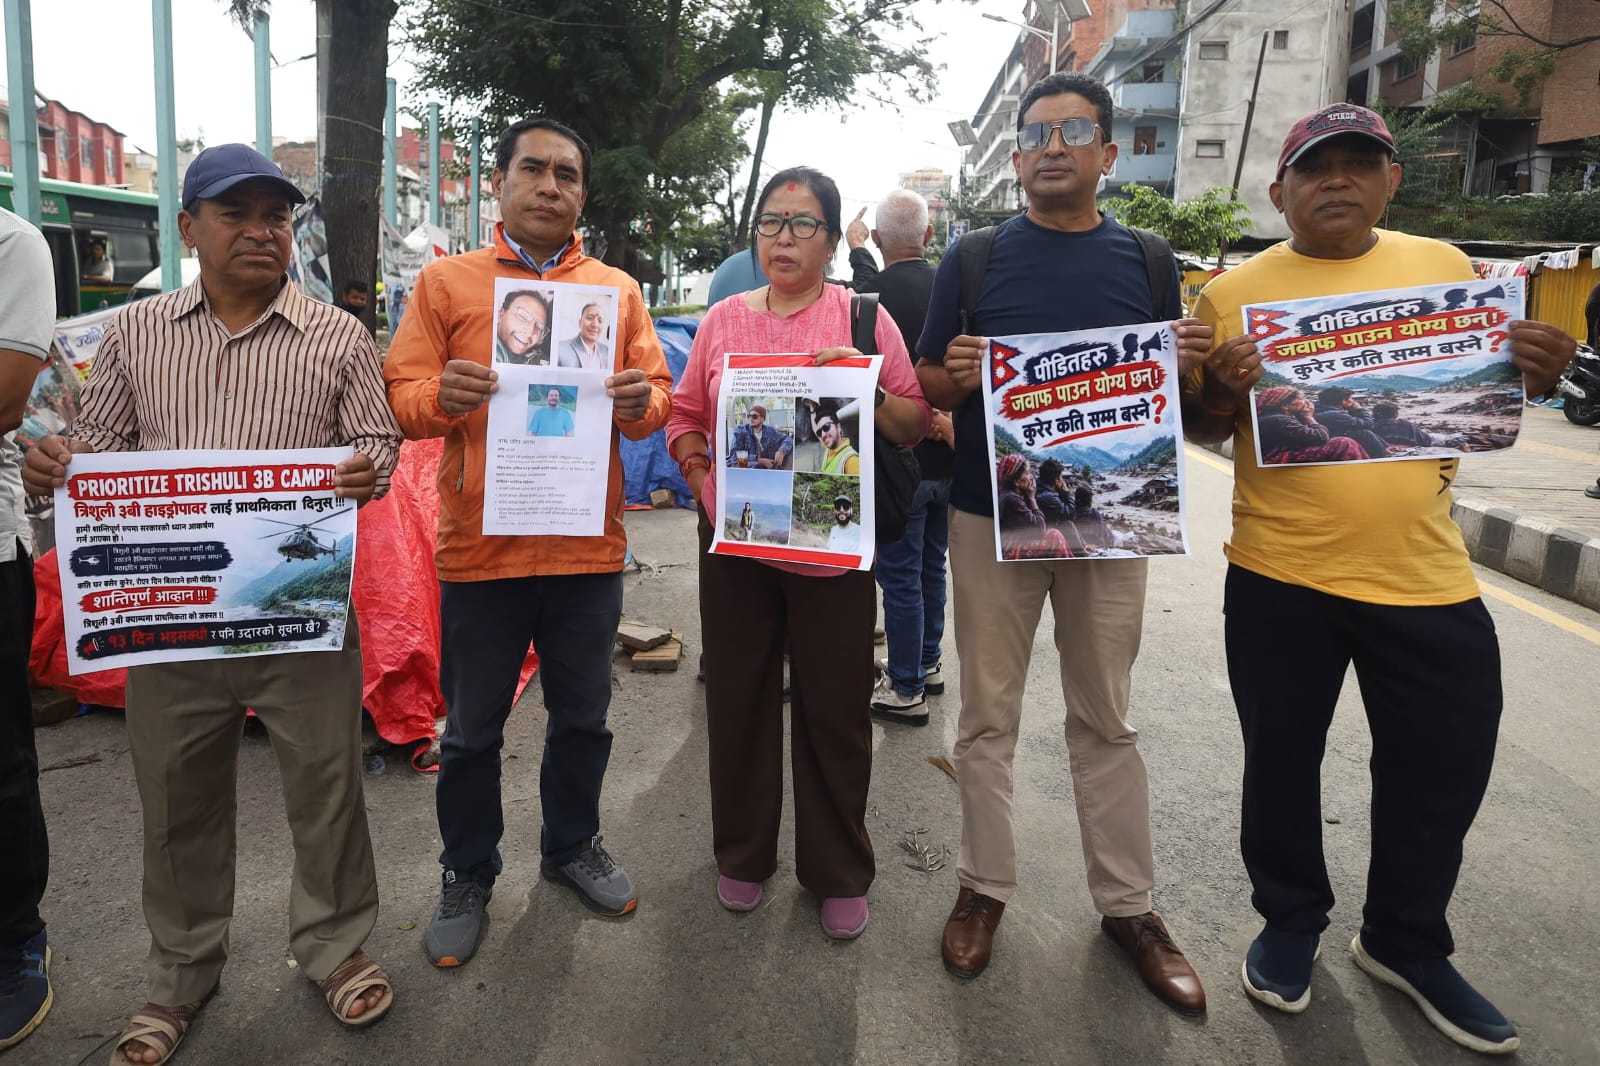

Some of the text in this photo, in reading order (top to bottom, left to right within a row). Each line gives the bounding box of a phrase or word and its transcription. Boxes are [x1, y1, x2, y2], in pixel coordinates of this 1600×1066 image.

[1275, 335, 1338, 358] जवाफ
[1341, 325, 1393, 348] पाउन
[1398, 316, 1448, 339] योग्य
[1292, 358, 1336, 381] कुरेर
[1341, 348, 1384, 369] कति
[1390, 344, 1432, 363] सम्म
[1010, 387, 1052, 413] जवाफ
[1055, 379, 1090, 403] पाउन
[1094, 370, 1127, 394] योग्य
[1022, 417, 1053, 447] कुरेर
[1055, 408, 1085, 433] कति
[1088, 408, 1117, 428] सम्म
[77, 475, 169, 497] PRIORITIZE
[174, 471, 247, 493] TRISHULI
[253, 469, 275, 489] 3B
[74, 501, 116, 521] त्रिशूली
[119, 501, 141, 519] ३बी
[144, 501, 208, 519] हाइड्रोपावर
[210, 499, 232, 515] लाई
[235, 498, 297, 513] प्राथमिकता
[302, 496, 334, 512] दिनुस्
[75, 523, 91, 534] हामी
[93, 588, 151, 608] शान्तिपूर्ण
[155, 589, 194, 603] आव्हान
[83, 617, 108, 628] त्रिशूली
[154, 612, 187, 621] प्राथमिकता
[108, 634, 127, 649] १३
[131, 629, 155, 645] दिन
[218, 627, 235, 639] पनि
[277, 623, 302, 637] सूचना
